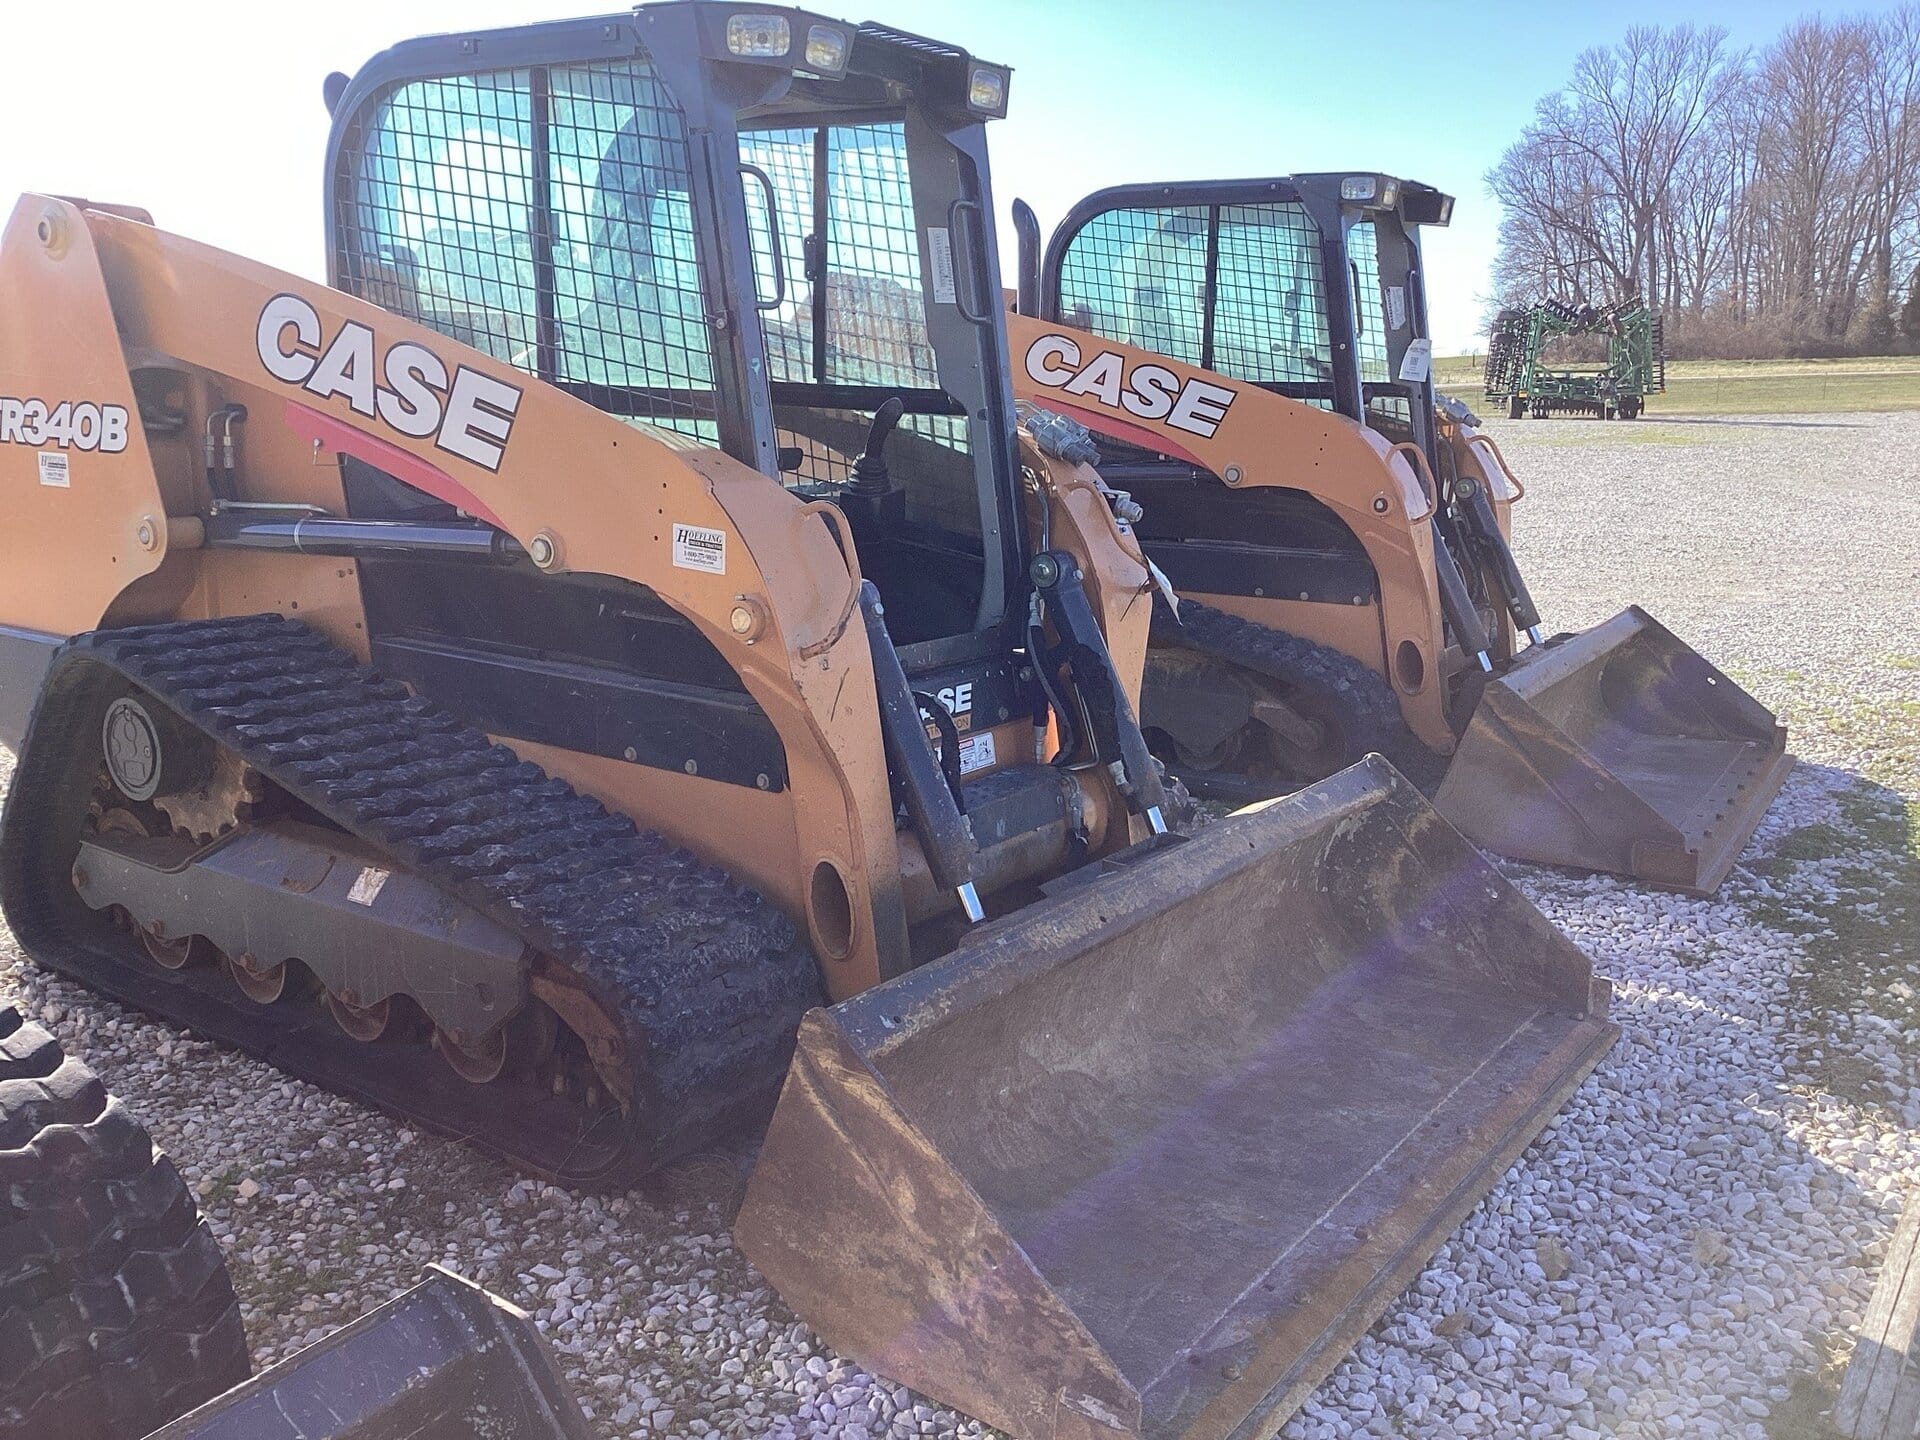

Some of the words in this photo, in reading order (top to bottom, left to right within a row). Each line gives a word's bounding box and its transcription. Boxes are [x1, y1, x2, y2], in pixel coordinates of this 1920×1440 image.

[257, 294, 523, 472] CASE
[1025, 335, 1237, 438] CASE
[0, 397, 129, 453] R340B
[676, 529, 723, 544] HOEFLING
